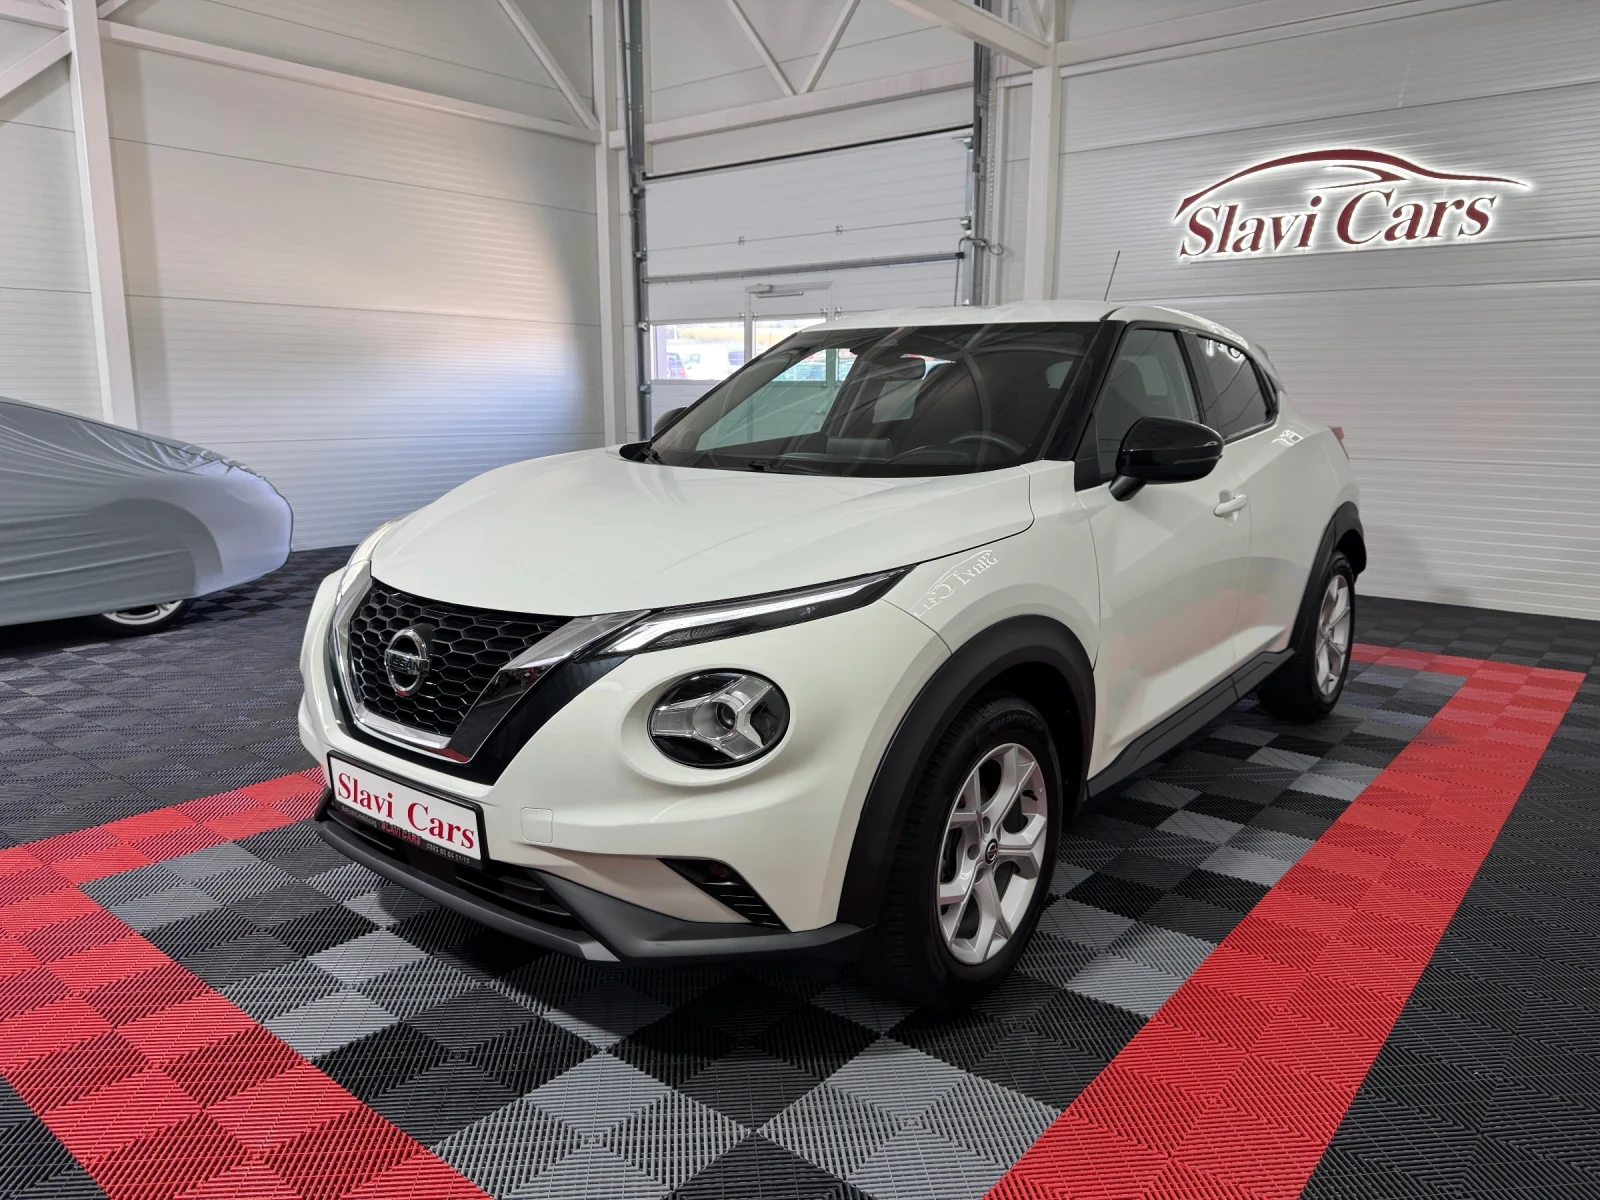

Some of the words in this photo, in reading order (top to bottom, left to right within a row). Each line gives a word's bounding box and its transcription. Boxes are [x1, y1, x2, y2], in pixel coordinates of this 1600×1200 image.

[1179, 195, 1323, 258] Slavi
[1336, 187, 1498, 245] Cars
[338, 772, 394, 820] Slavi
[407, 802, 475, 849] Cars
[381, 821, 401, 837] SLAVI
[401, 829, 422, 846] CARS
